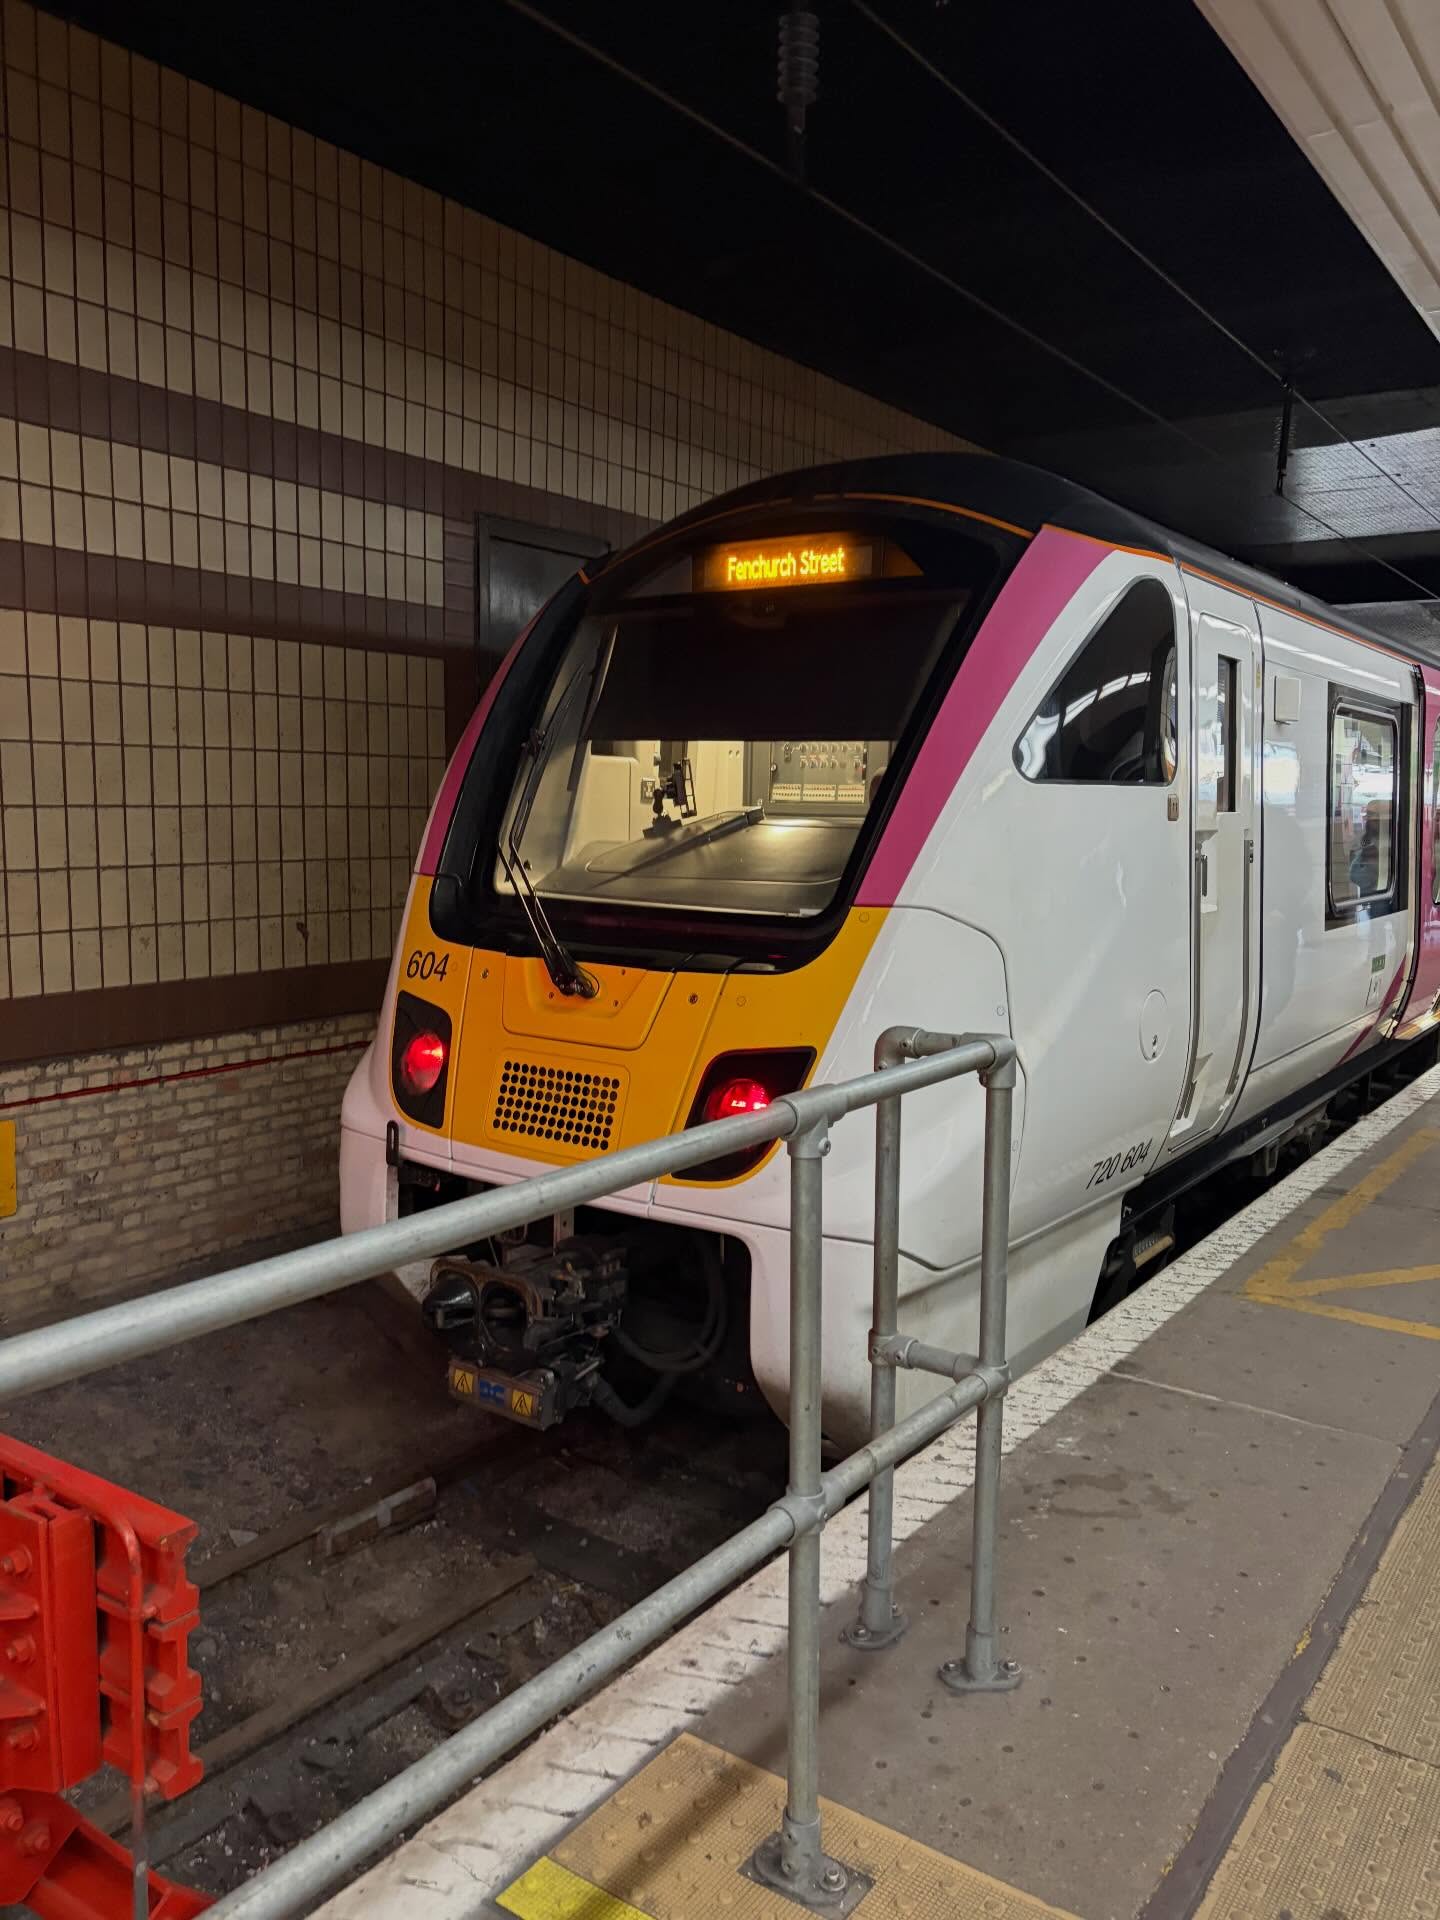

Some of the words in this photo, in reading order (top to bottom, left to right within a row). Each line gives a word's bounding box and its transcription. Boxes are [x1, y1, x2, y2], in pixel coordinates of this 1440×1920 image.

[727, 552, 796, 581] Fenchurch
[799, 546, 845, 575] Street
[406, 950, 450, 982] 604
[1085, 1151, 1122, 1190] 720
[1120, 1137, 1153, 1174] 604
